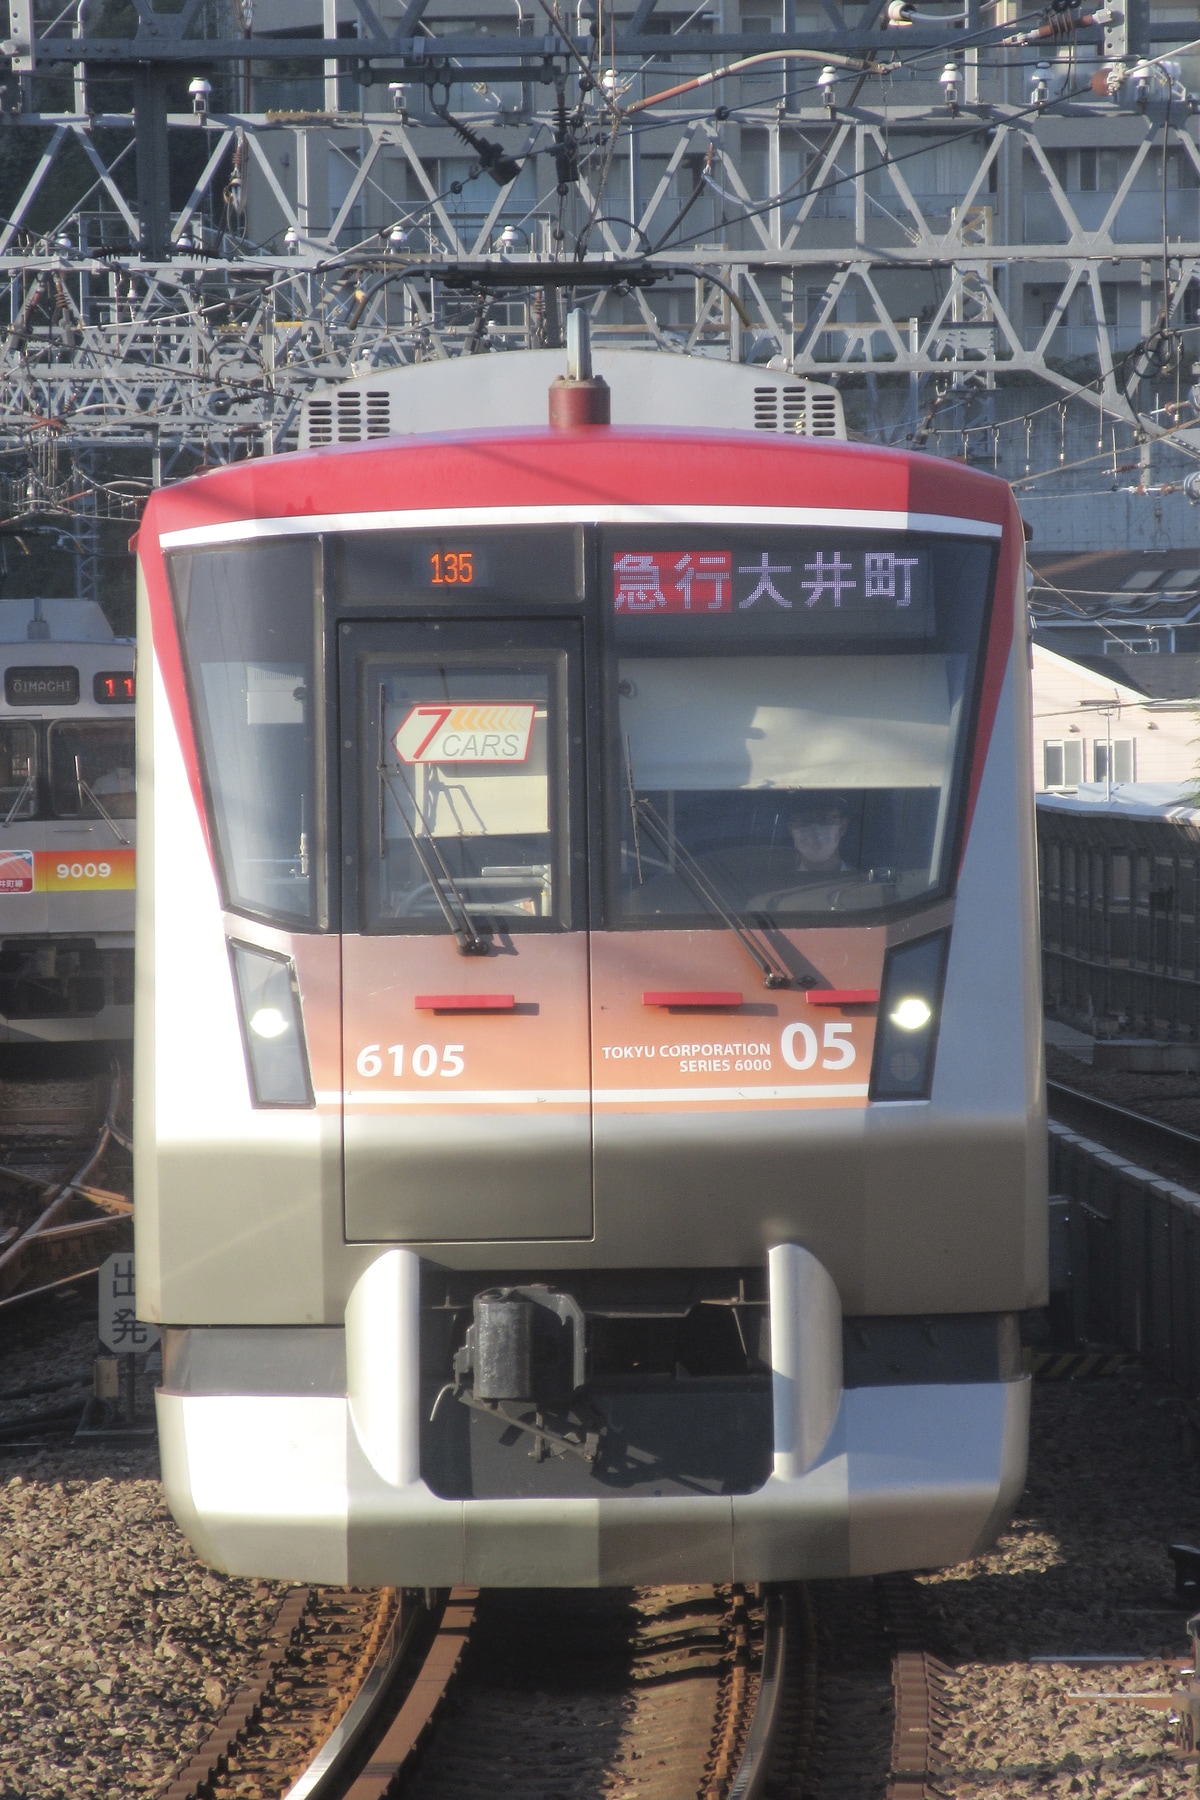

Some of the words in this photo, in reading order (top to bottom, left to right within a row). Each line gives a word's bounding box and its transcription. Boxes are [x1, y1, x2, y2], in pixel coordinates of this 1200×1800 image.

[430, 552, 473, 584] 135
[413, 708, 452, 760] 7
[442, 734, 520, 757] CARS
[56, 862, 111, 879] 9009
[356, 1044, 466, 1078] 6105
[602, 1045, 656, 1059] TOKYU
[659, 1043, 772, 1058] CORPORATION
[780, 1022, 857, 1071] 05
[679, 1060, 731, 1073] SERIES
[734, 1059, 772, 1072] 6000
